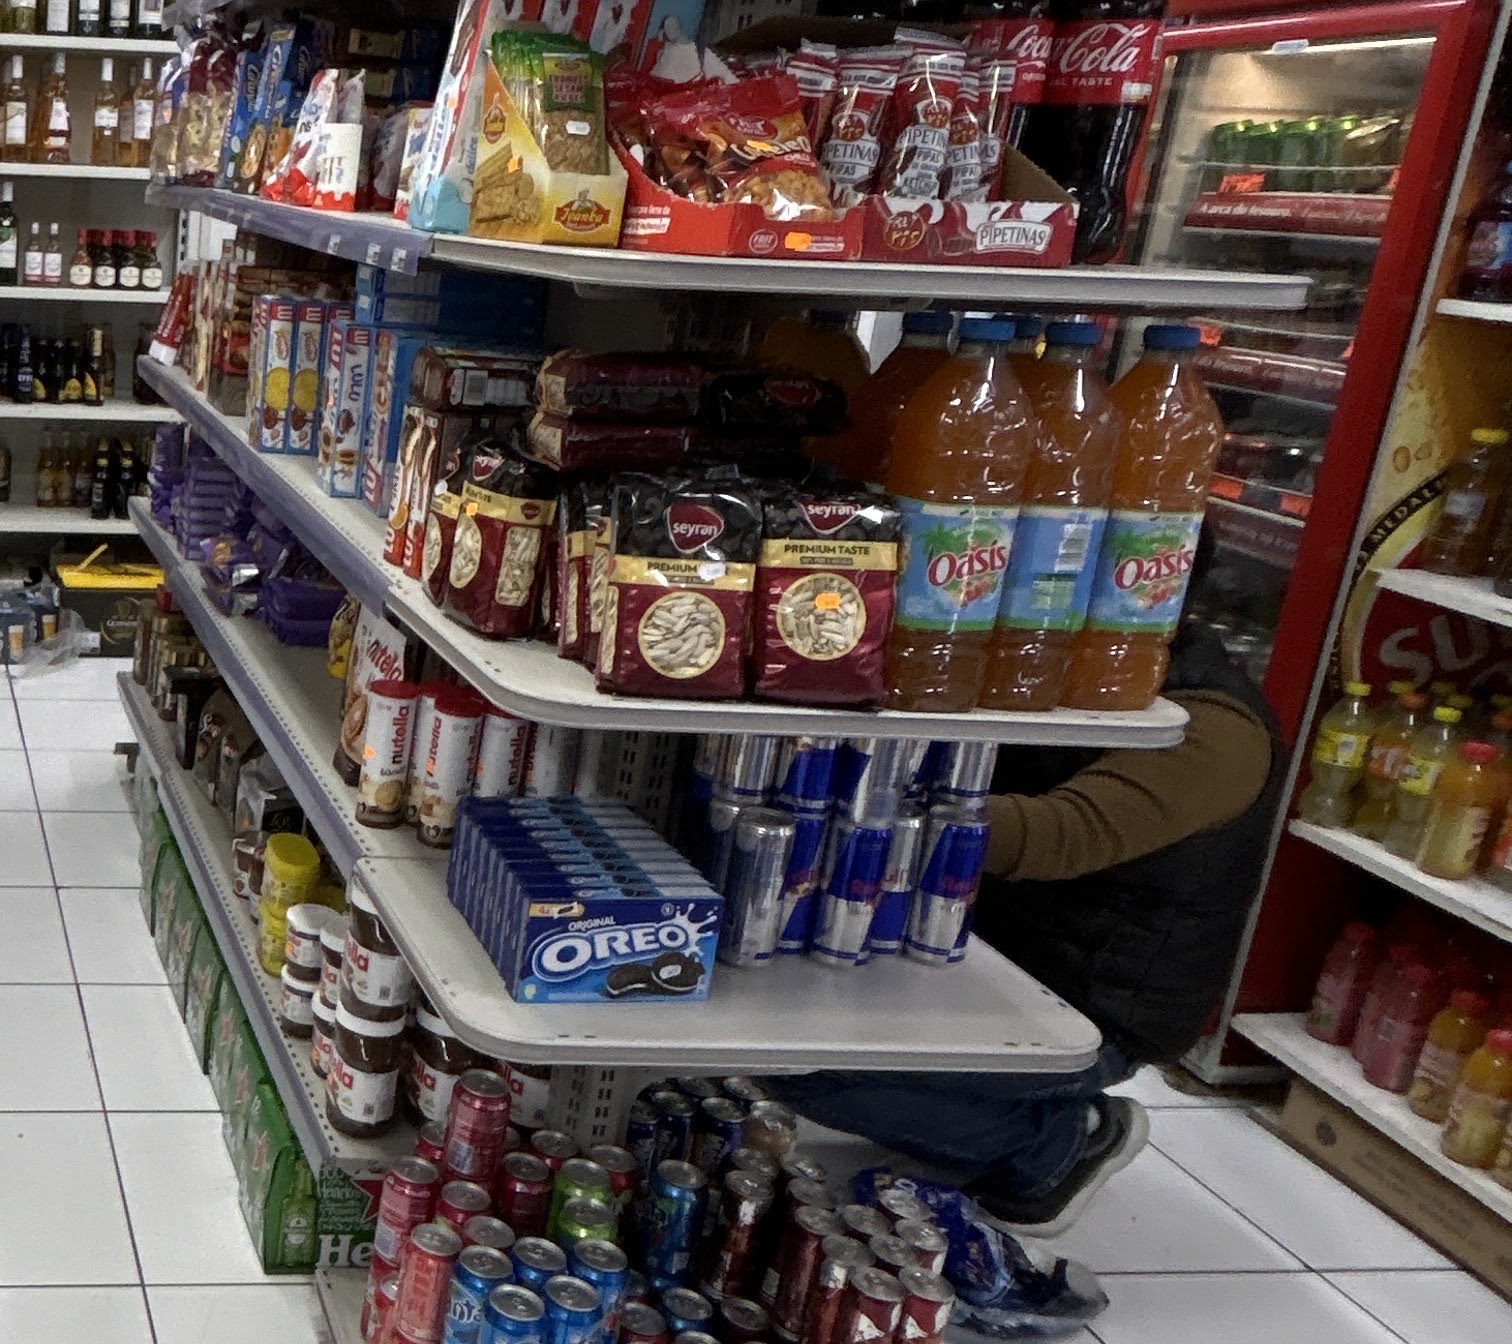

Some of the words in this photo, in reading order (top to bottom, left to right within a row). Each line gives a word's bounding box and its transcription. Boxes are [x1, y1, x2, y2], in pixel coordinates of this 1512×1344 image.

[1059, 22, 1153, 74] Cola
[979, 223, 1046, 247] PIPETINAS
[672, 521, 718, 537] seyran
[783, 544, 836, 556] PREMIUM
[838, 544, 871, 556] TASTE
[646, 559, 697, 573] PREMIUM
[927, 542, 1008, 587] Oasis
[1113, 543, 1193, 591] Oasis
[391, 705, 410, 765] nutella
[507, 725, 526, 786] nutella
[567, 915, 617, 932] ORIGINAL
[541, 923, 687, 973] OREO
